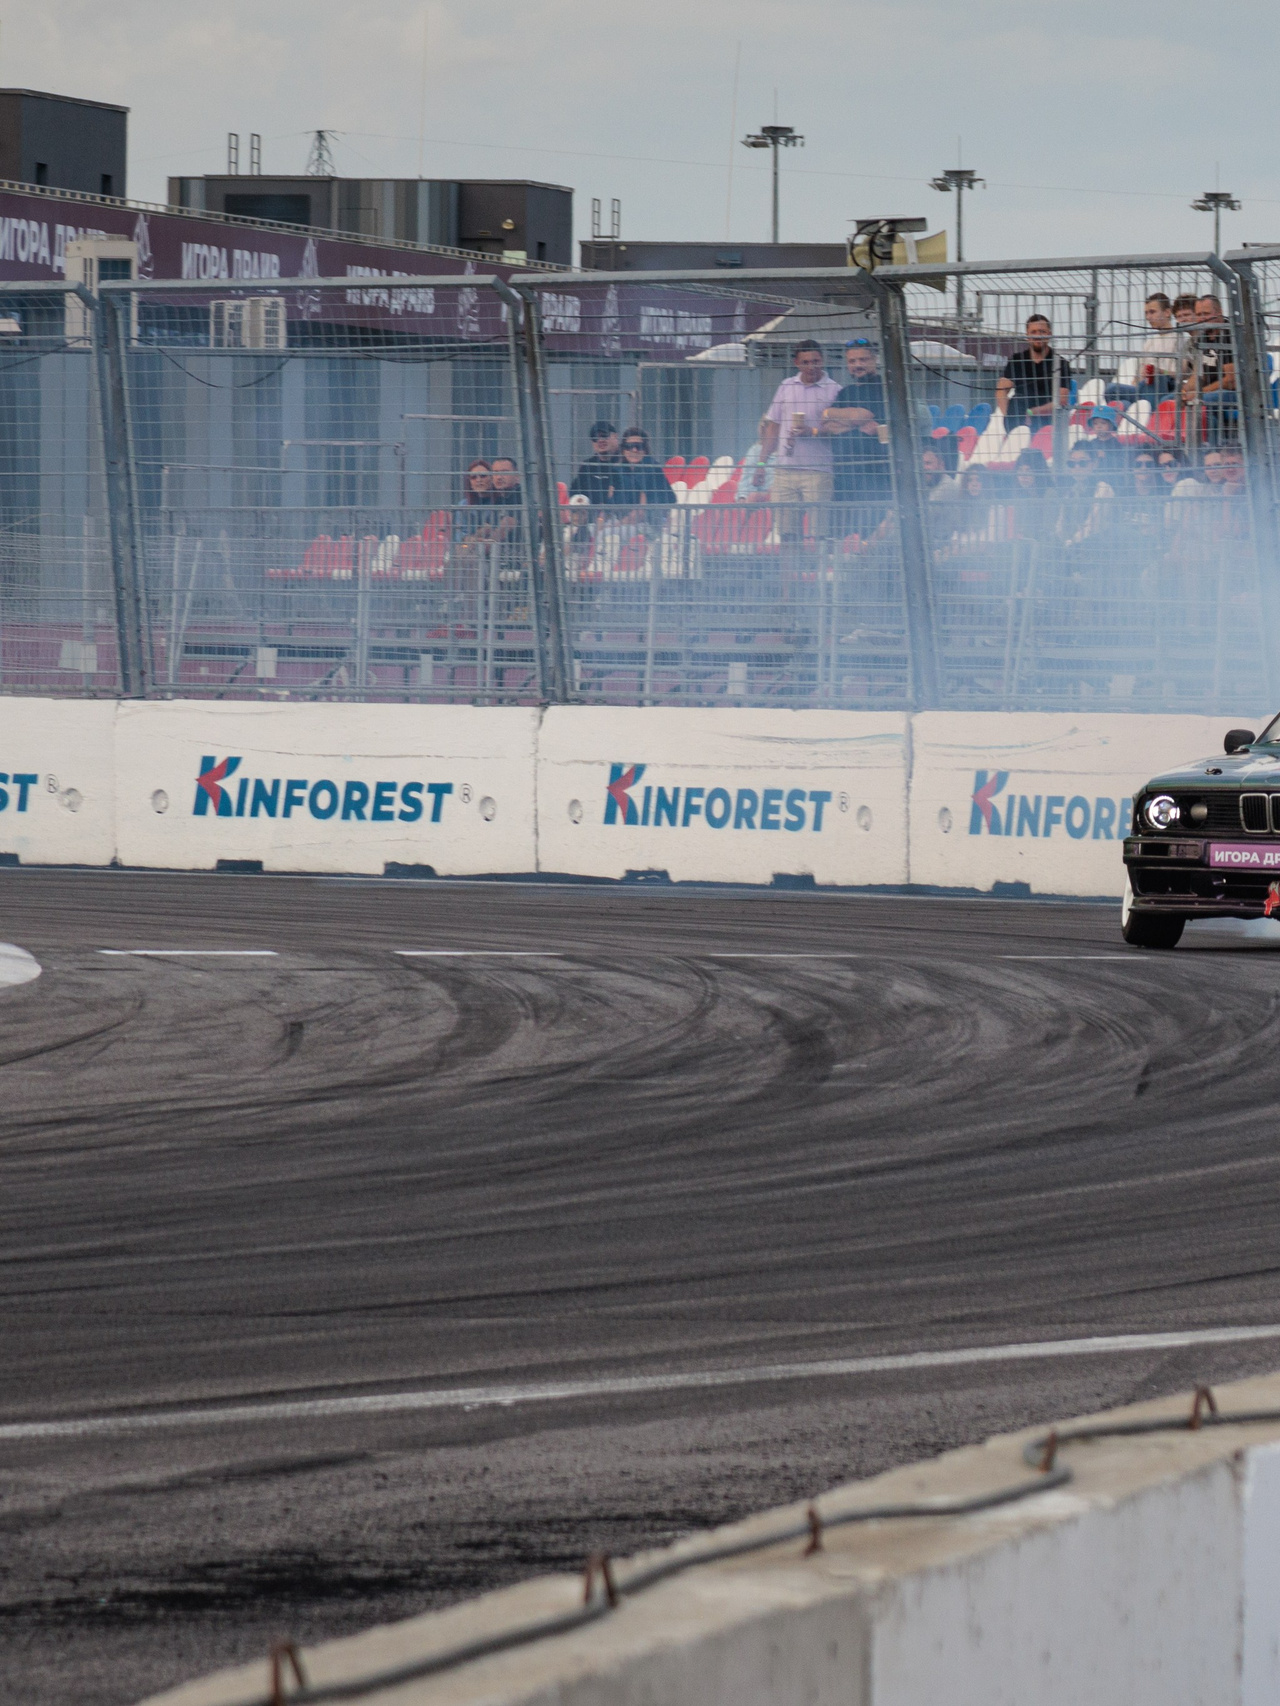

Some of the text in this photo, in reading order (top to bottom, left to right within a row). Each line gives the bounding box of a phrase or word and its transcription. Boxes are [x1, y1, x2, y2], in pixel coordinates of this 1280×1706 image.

[182, 242, 229, 279] ИГОРА
[193, 756, 453, 822] KINFOREST
[603, 763, 831, 832] KINFOREST
[968, 770, 1132, 840] KINFORE
[1214, 850, 1260, 863] ИГОРА
